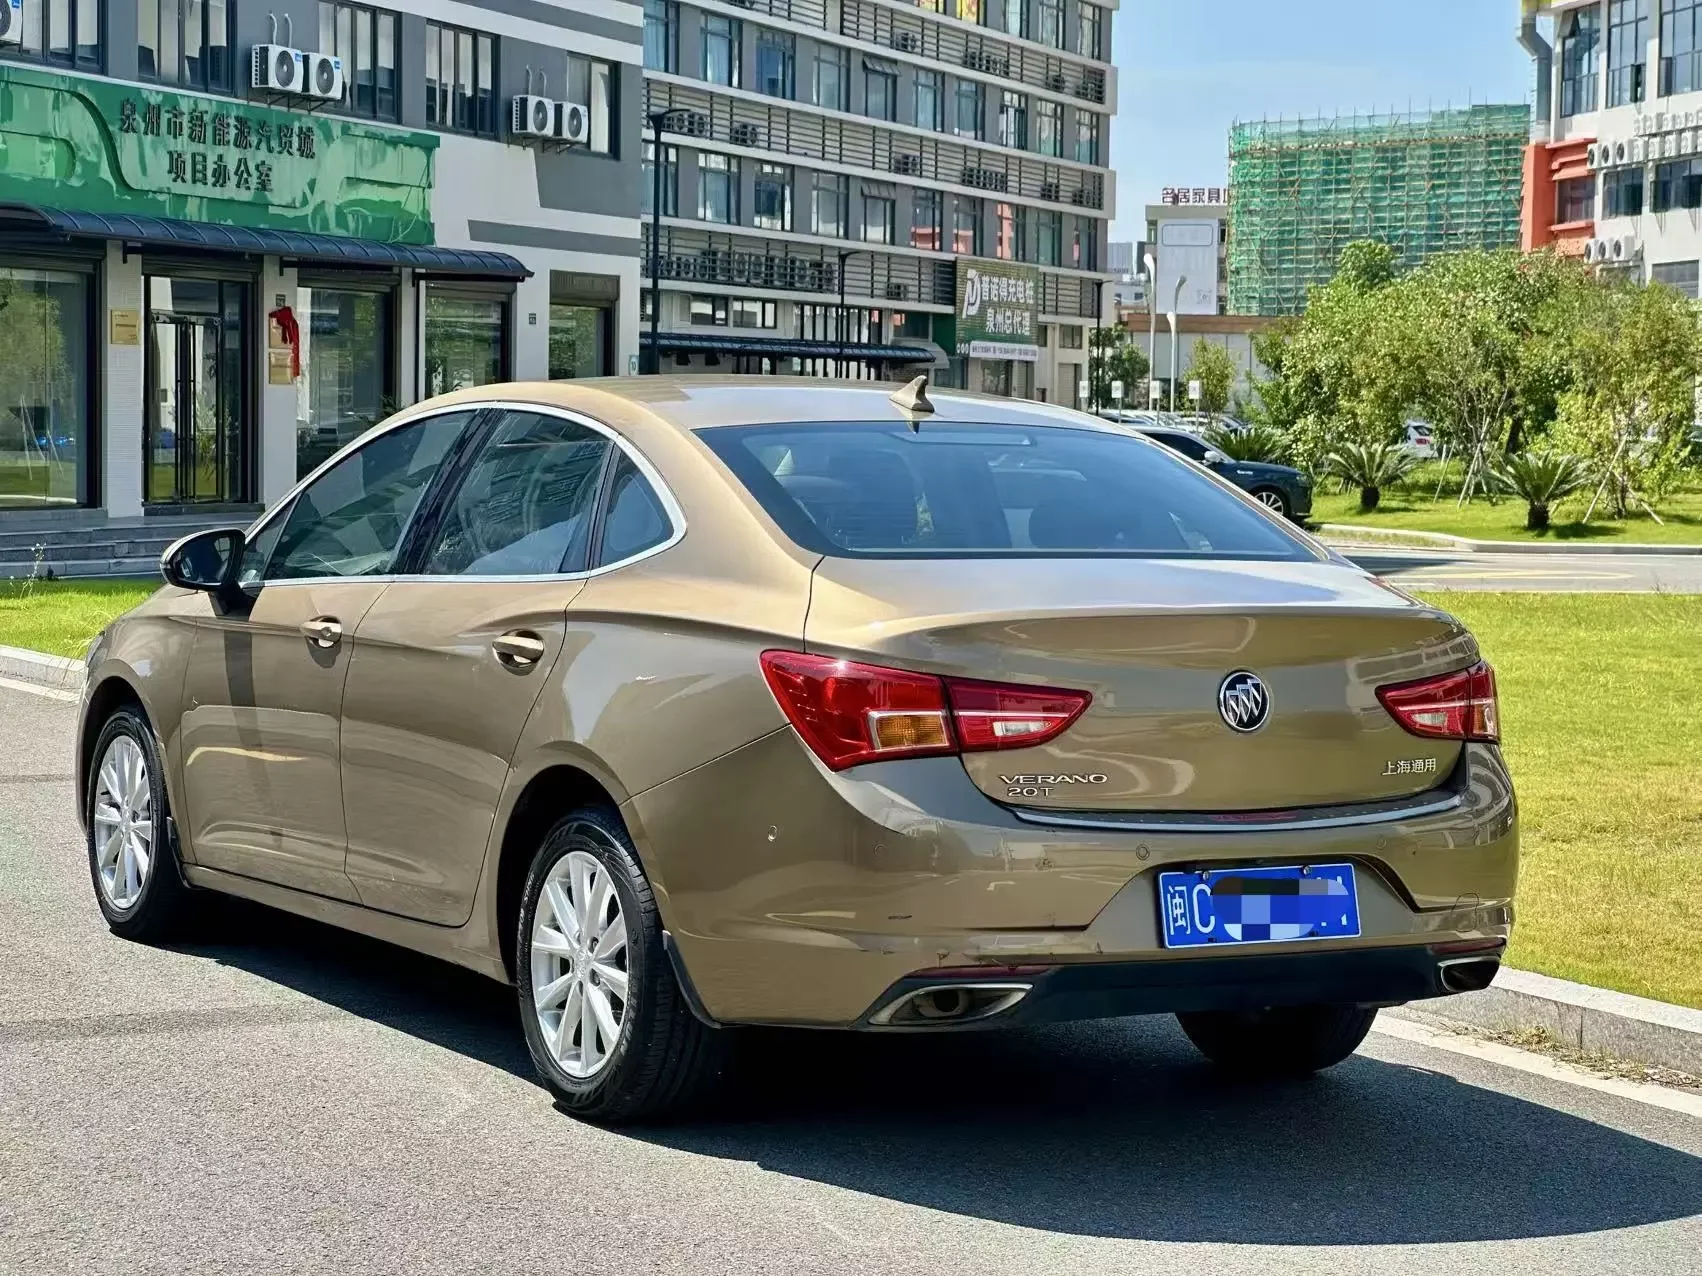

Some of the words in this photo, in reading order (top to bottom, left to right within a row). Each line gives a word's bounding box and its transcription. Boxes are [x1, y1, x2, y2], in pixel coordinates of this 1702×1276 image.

[120, 97, 315, 159] 泉州市新能源汽贸城
[167, 149, 273, 192] 项目办公室
[1161, 186, 1228, 204] 名居家具
[986, 306, 1031, 336] 泉州总代理
[1382, 758, 1437, 776] 上海通用
[999, 774, 1108, 784] VERANO
[1008, 787, 1054, 797] 20T
